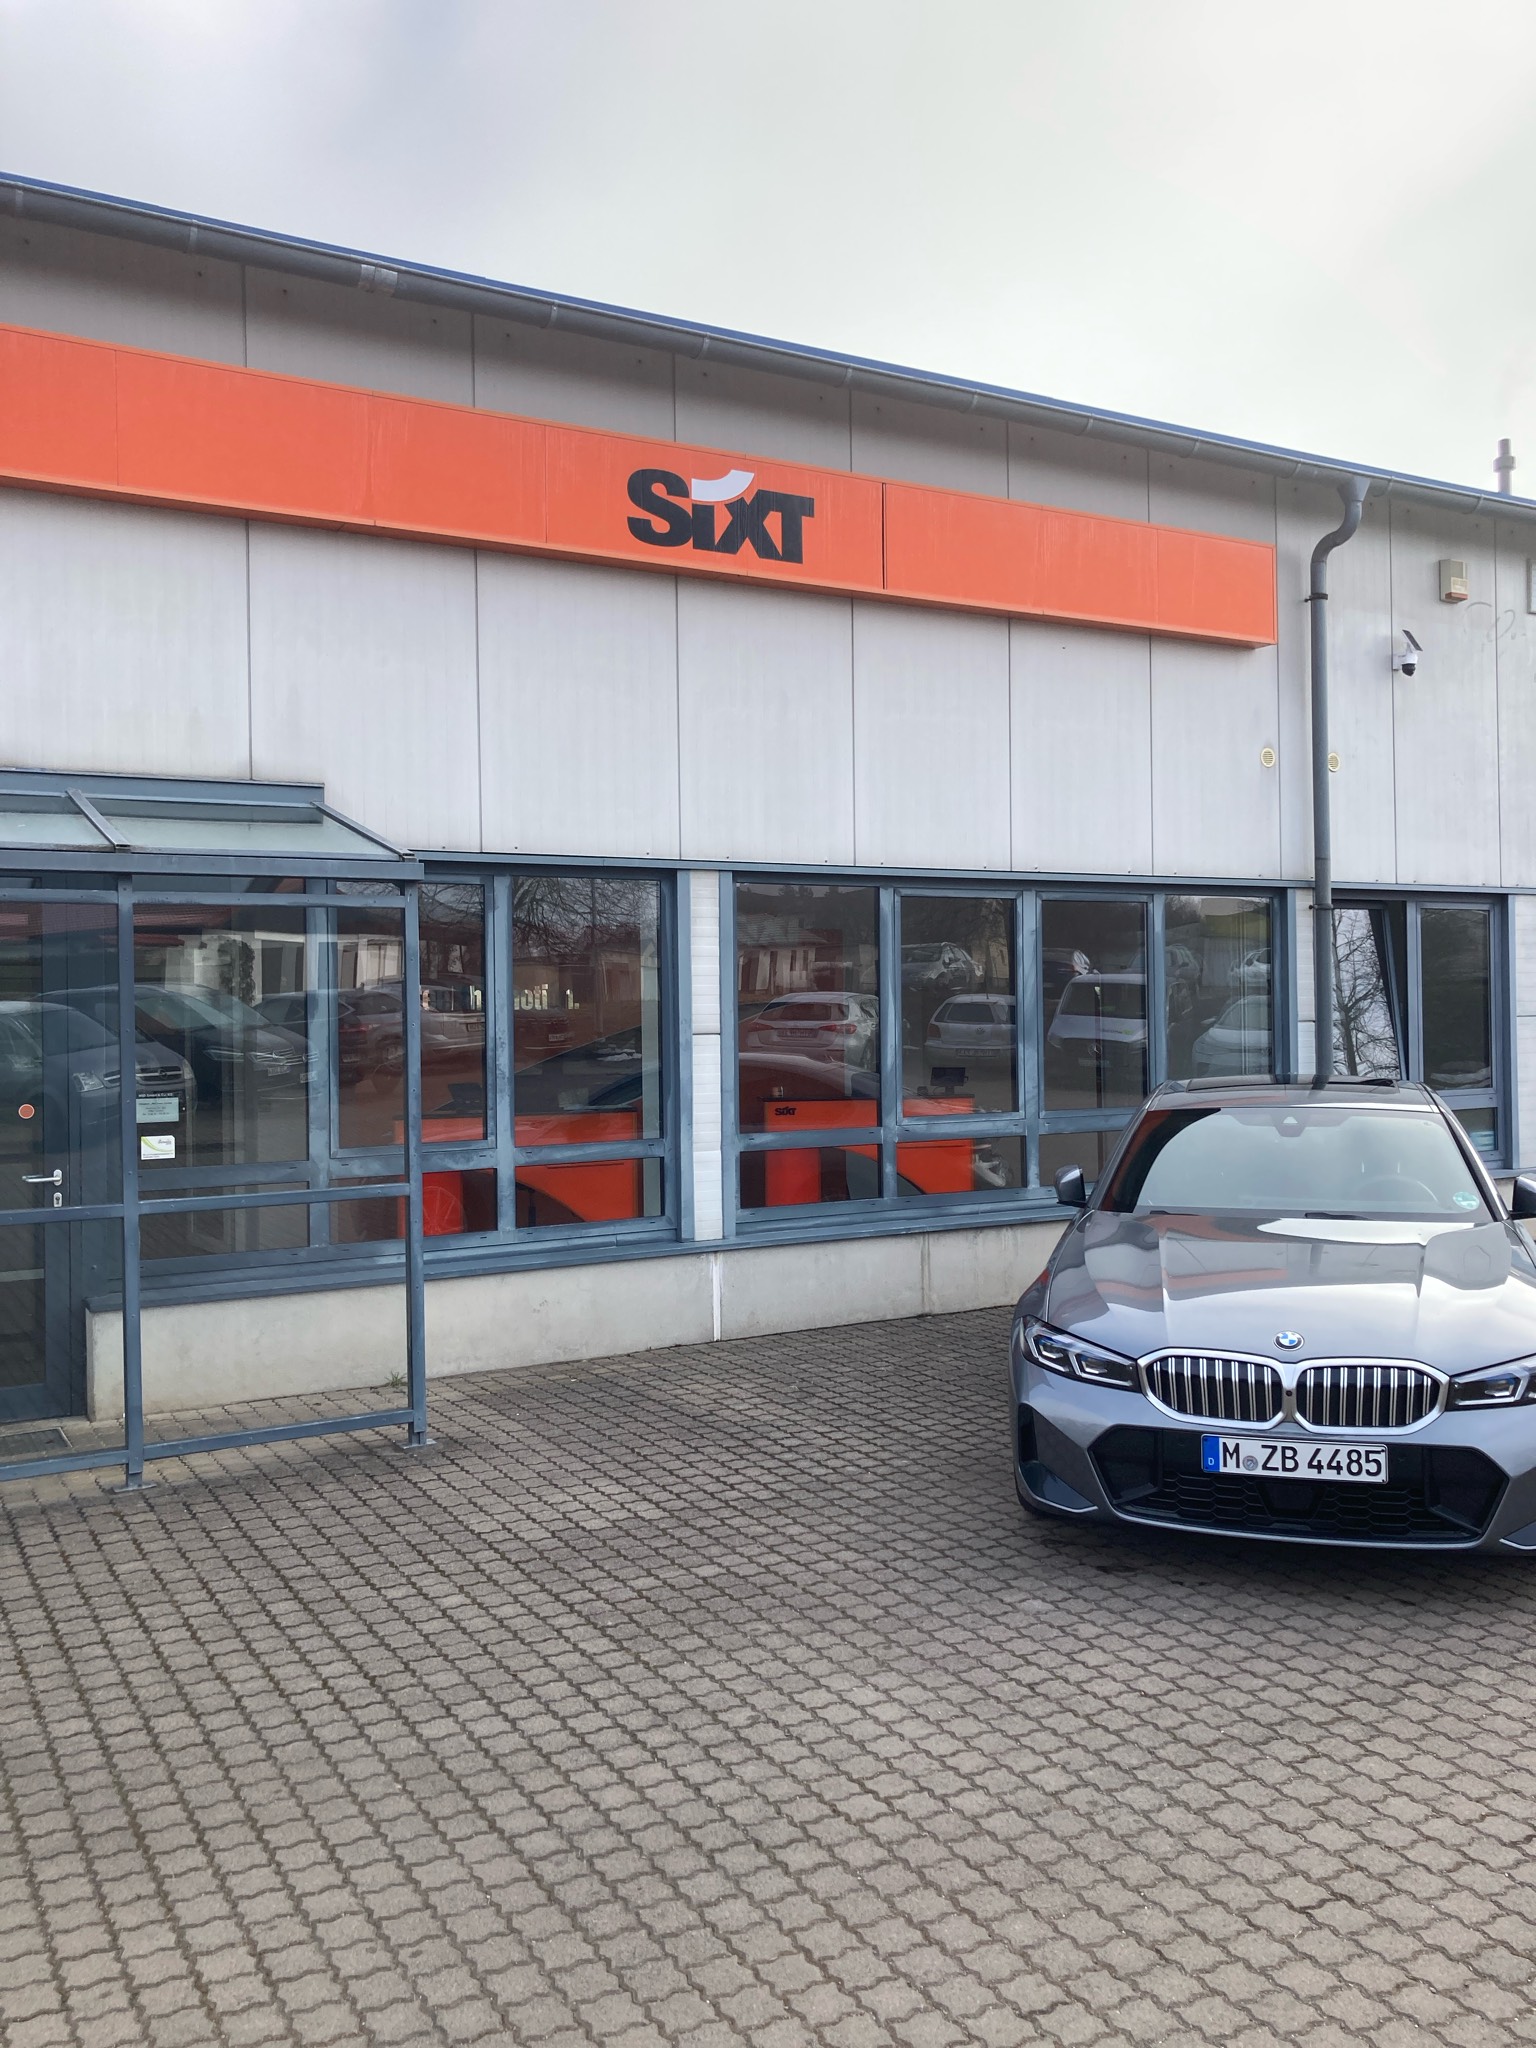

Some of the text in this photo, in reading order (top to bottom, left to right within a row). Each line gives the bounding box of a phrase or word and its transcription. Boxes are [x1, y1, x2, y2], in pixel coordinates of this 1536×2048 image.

[1207, 1457, 1215, 1466] D
[1222, 1441, 1382, 1477] M ZB 4485
